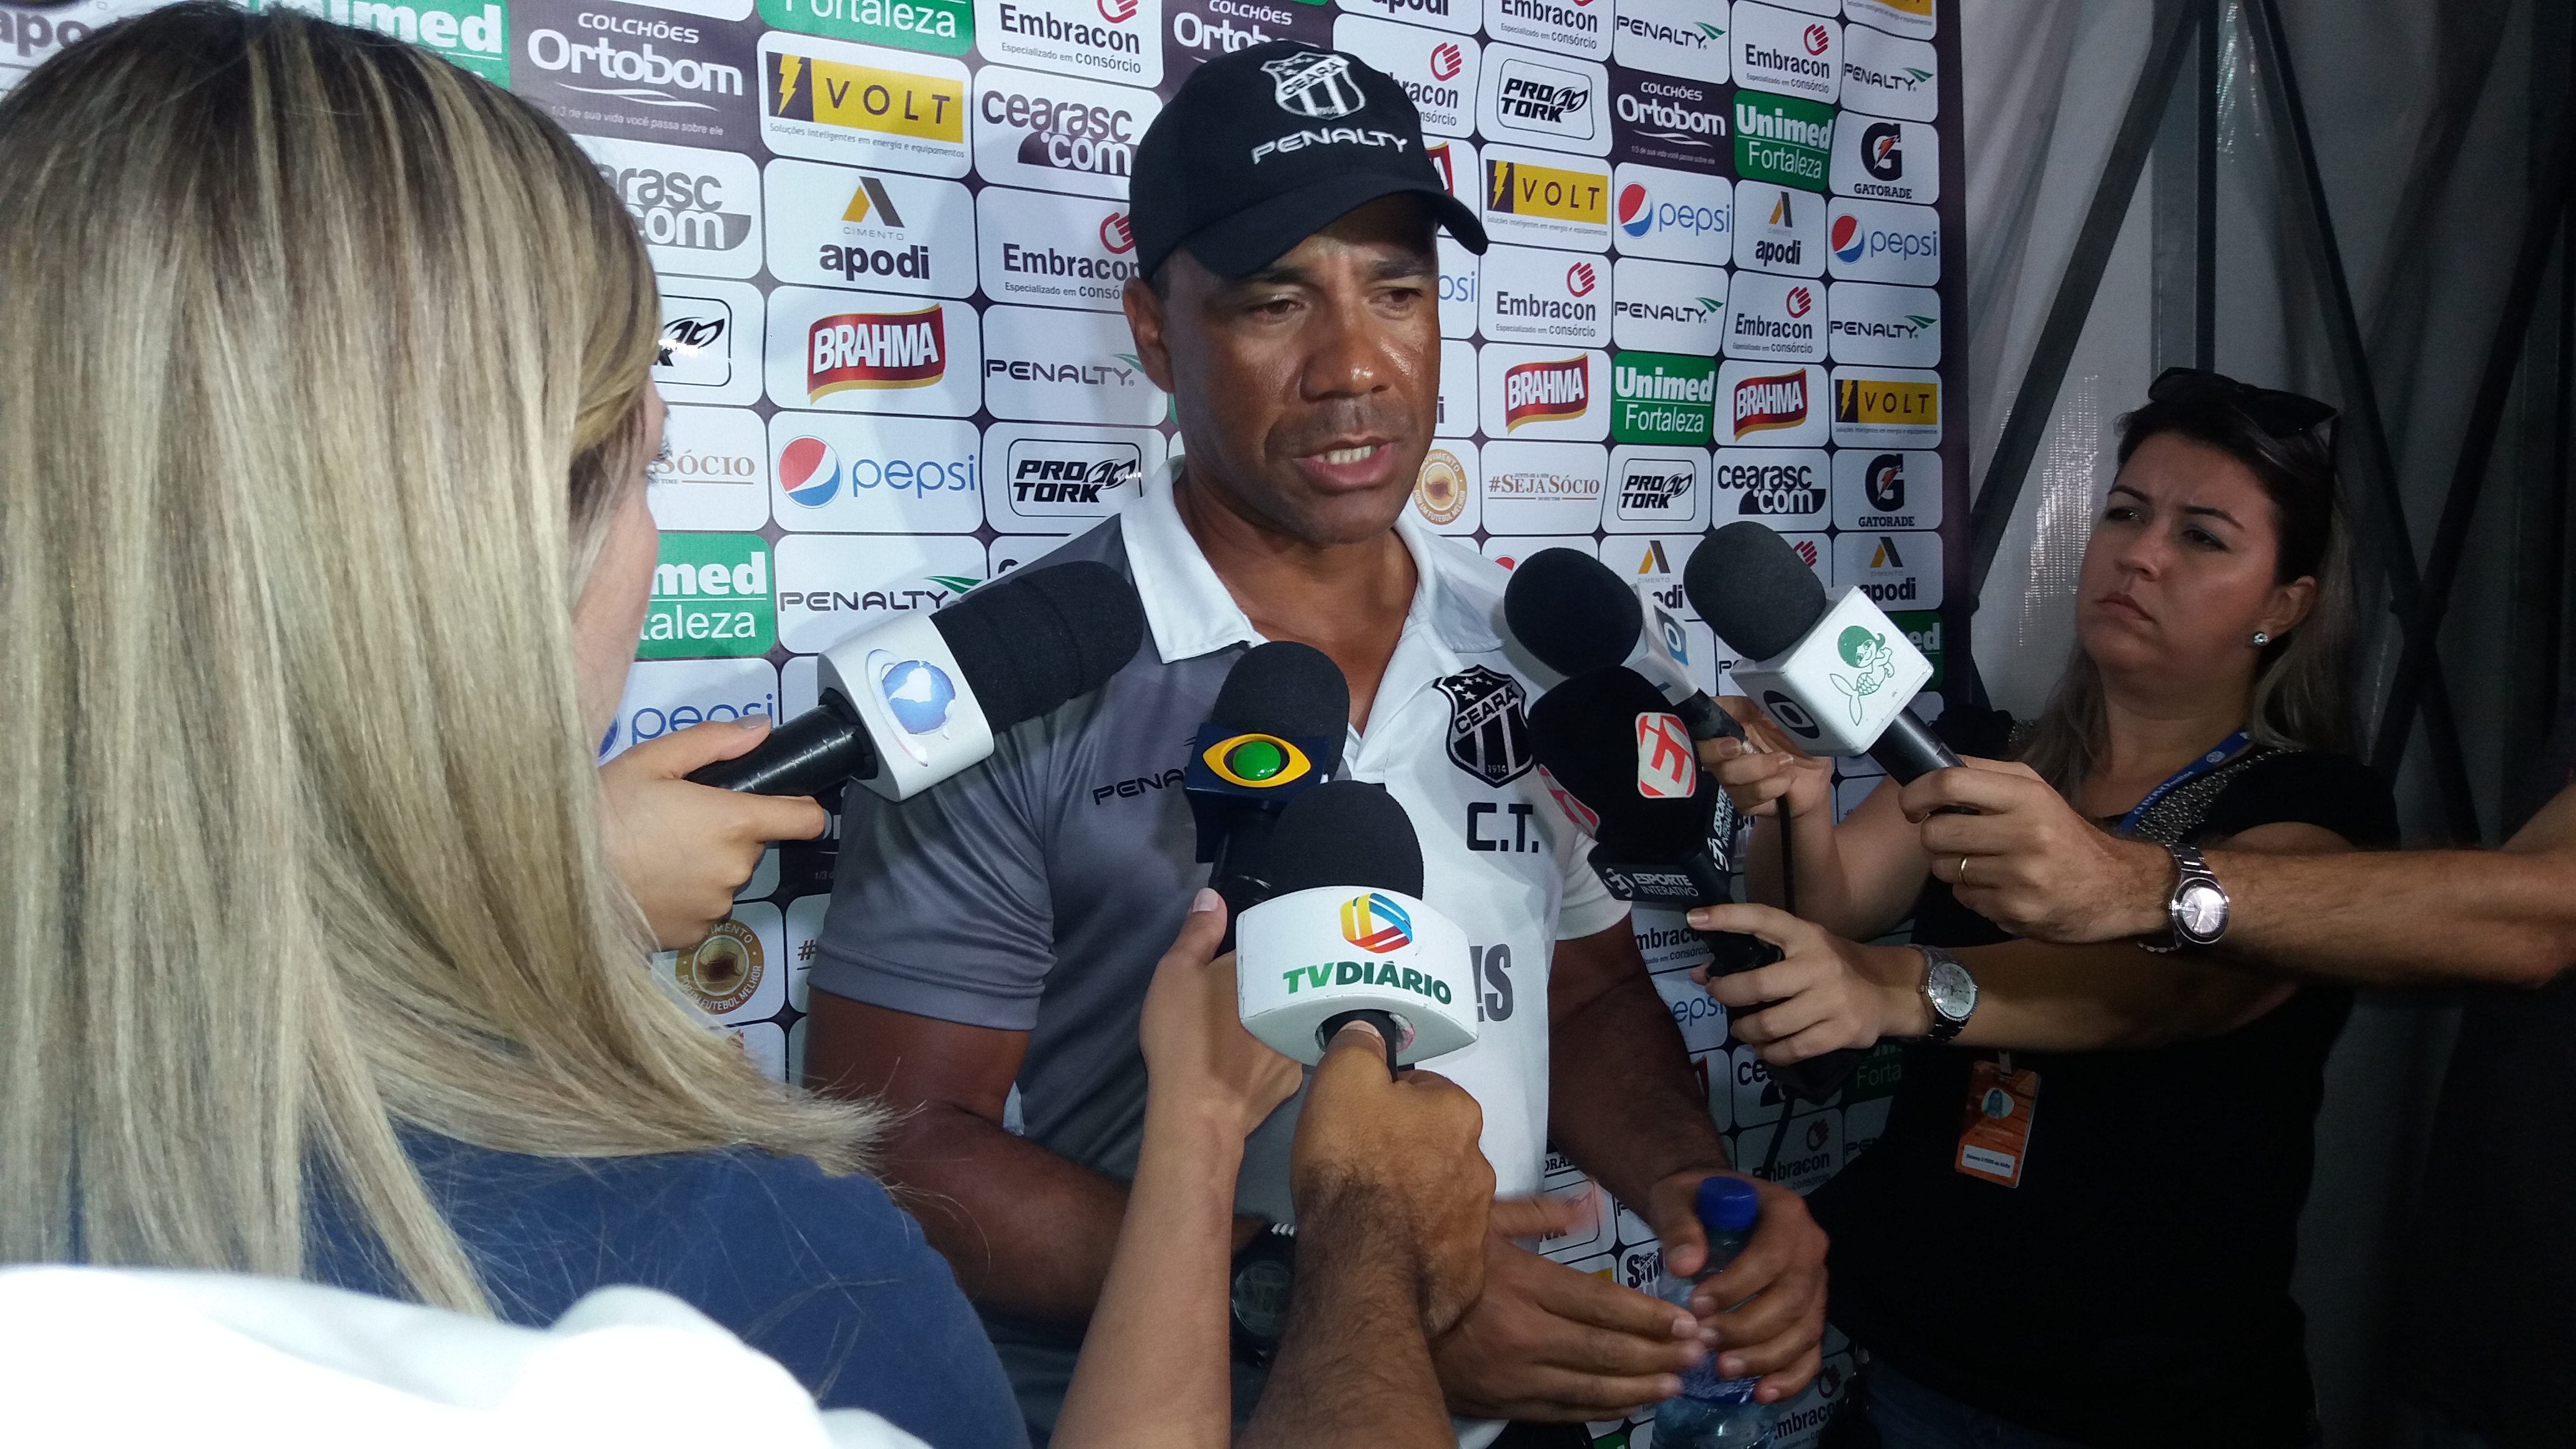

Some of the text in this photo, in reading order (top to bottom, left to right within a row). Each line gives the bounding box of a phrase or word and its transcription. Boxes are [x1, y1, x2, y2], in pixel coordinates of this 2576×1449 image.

[1209, 0, 1293, 26] COLCHÕES
[578, 12, 700, 44] COLCHÕES
[999, 2, 1140, 55] Embracon
[1500, 23, 1539, 37] Especializado
[1551, 31, 1598, 49] consórcio
[1616, 16, 1707, 49] PENALTY
[527, 29, 743, 95] Ortobom
[1002, 42, 1141, 74] Especializado em consórcio
[1745, 44, 1830, 79] Embracon
[1503, 78, 1554, 102] PRO
[1641, 81, 1702, 101] COLCHÕES
[1790, 77, 1830, 94] consórcio
[1843, 63, 1915, 92] PENALTY
[826, 77, 951, 125] VOLT
[1500, 97, 1564, 123] TORK
[1617, 94, 1726, 137] Ortobom
[569, 108, 581, 118] de
[583, 111, 602, 120] sua
[603, 114, 624, 123] vida
[650, 119, 680, 130] passa
[681, 122, 707, 134] sobre
[710, 125, 724, 135] ele
[982, 90, 1133, 143] cearasc
[1420, 110, 1457, 126] nsórcio
[1735, 104, 1833, 150] Unimed
[769, 123, 805, 137] Soluções
[858, 137, 870, 145] em
[872, 139, 902, 150] energia
[911, 145, 964, 159] equipamentos
[1251, 127, 1408, 165] PENALTY
[1748, 142, 1822, 180] Fortaleza
[1522, 178, 1600, 210] VOLT
[1853, 182, 1912, 200] GATORADE
[843, 227, 904, 241] CIMENTO
[1659, 203, 1730, 236] pepsi
[1755, 240, 1801, 266] apodi
[1870, 231, 1937, 260] pepsi
[819, 244, 930, 282] apodi
[1005, 282, 1061, 295] Especializado
[1063, 288, 1076, 296] em
[1496, 291, 1596, 321] Embracon
[1614, 301, 1707, 323] PENALTY
[1496, 323, 1536, 334] Especializado
[1549, 324, 1596, 338] consórcio
[1735, 313, 1812, 339] Embracon
[1830, 321, 1918, 339] PENALTY
[812, 321, 940, 374] BRAHMA
[1771, 343, 1813, 354] consórcio
[987, 359, 1133, 386] PENALTY
[1615, 366, 1715, 402] Unimed
[1508, 367, 1585, 411] BRAHMA
[1736, 381, 1804, 421] BRAHMA
[1864, 392, 1930, 414] VOLT
[1626, 404, 1705, 433] Fortaleza
[852, 454, 975, 499] pepsi
[1016, 460, 1088, 481] PRO
[1625, 476, 1664, 491] PRO
[1718, 465, 1813, 490] cearasc
[1013, 482, 1100, 503] TORK
[1621, 493, 1672, 509] TORK
[1858, 516, 1915, 527] GATORADE
[780, 590, 949, 612] PENALTY
[1488, 764, 1506, 773] 1914
[1093, 769, 1187, 806] PENA
[1714, 788, 1727, 836] ESPORTE
[1722, 798, 1734, 847] INTERATIVO
[1466, 802, 1538, 853] C.T.
[1632, 873, 1693, 886] ESPORTE
[1641, 886, 1699, 897] INTERATIVO
[739, 965, 762, 1000] MELHOR
[1673, 996, 1724, 1027] epsi
